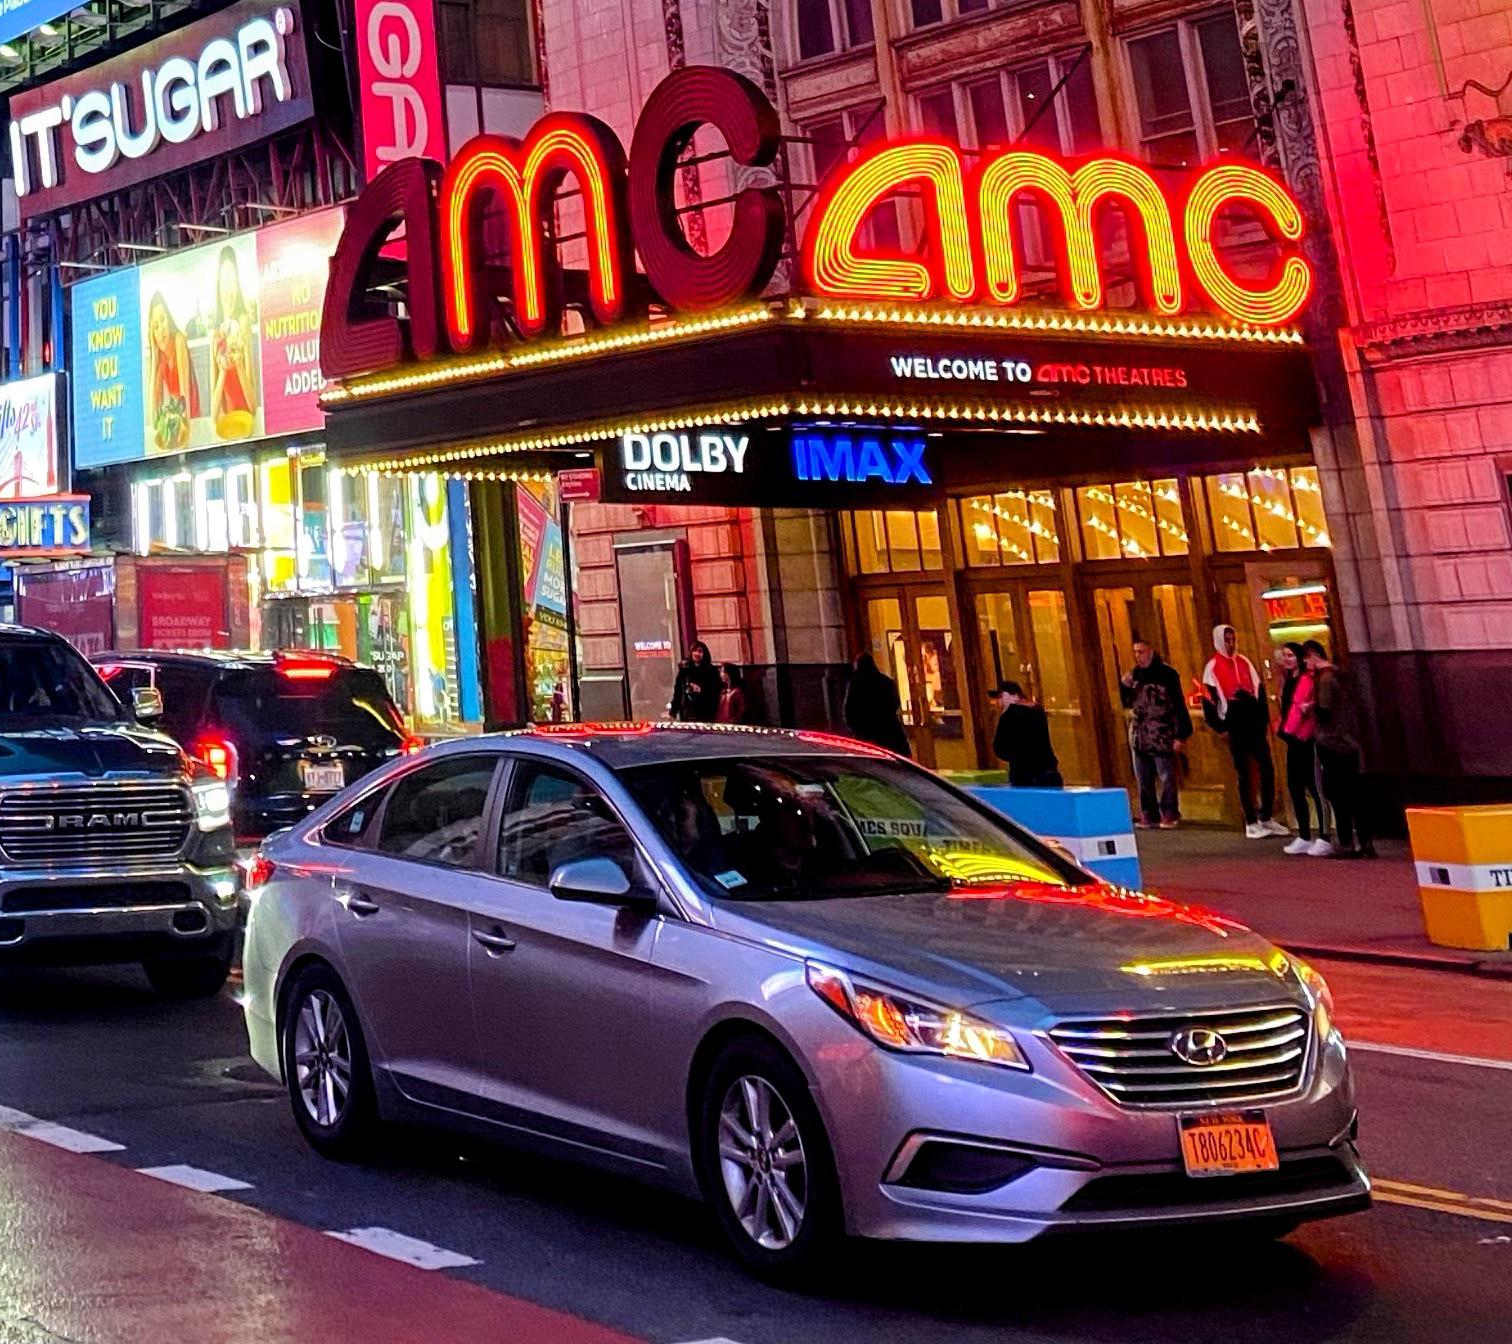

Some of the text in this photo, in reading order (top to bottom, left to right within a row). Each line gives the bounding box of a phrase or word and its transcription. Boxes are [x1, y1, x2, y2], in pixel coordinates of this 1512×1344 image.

[9, 15, 291, 198] IT'SUGAR
[93, 296, 117, 320] YOU
[265, 309, 320, 340] NUTRITIO
[88, 326, 125, 355] KNOW
[94, 356, 118, 380] YOU
[890, 356, 998, 381] WELCOME
[1001, 362, 1032, 382] TO
[1094, 366, 1187, 387] THEATRES
[284, 368, 327, 396] ADDED
[91, 387, 125, 411] WANT
[100, 417, 115, 441] IT
[624, 433, 932, 484] DOLBY IMAX
[625, 473, 691, 491] CINEMA
[152, 616, 211, 628] BROADWAY
[59, 813, 138, 828] RAM
[1489, 868, 1512, 887] TI
